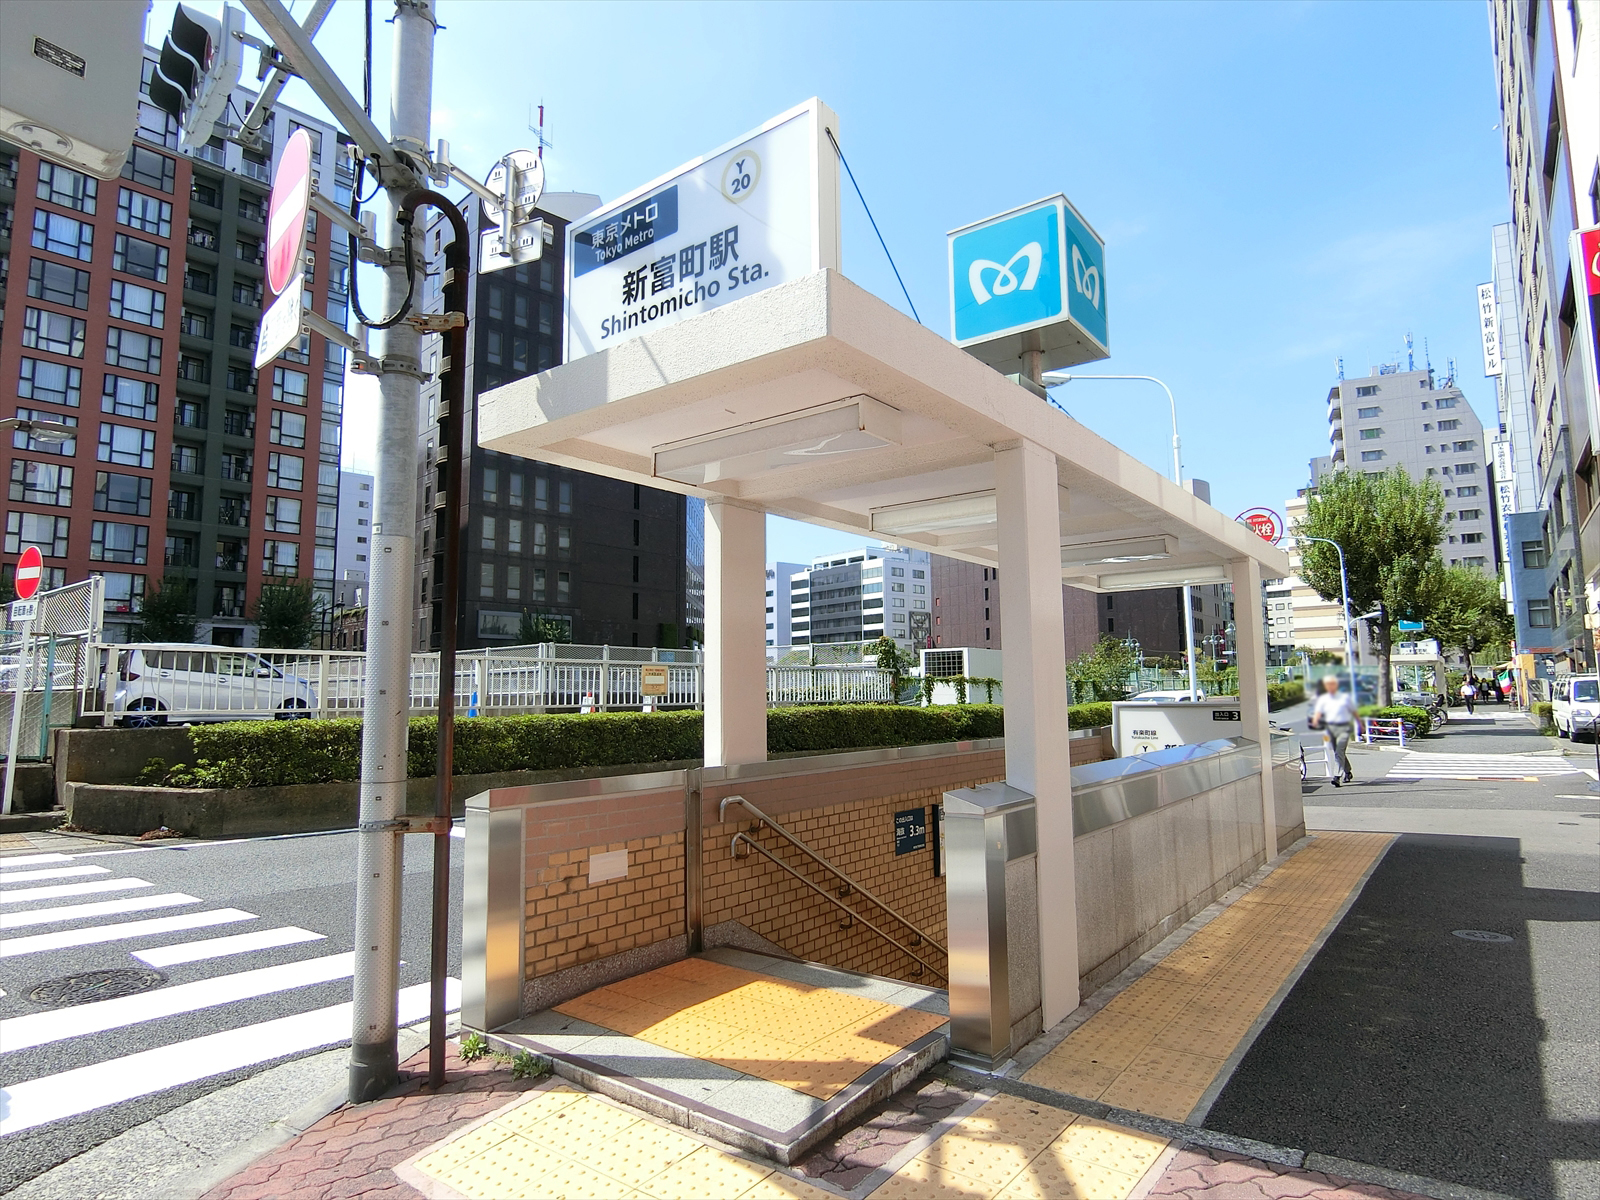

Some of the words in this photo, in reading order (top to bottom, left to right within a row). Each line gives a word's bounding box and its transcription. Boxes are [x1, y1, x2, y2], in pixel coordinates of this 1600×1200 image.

[731, 173, 751, 195] 20
[736, 159, 746, 175] Y
[591, 202, 659, 250] 東京メトロ
[595, 242, 623, 262] Tokyo
[624, 228, 654, 250] Metro
[622, 224, 739, 306] 新富町駅
[601, 280, 721, 340] Shintomicho
[728, 262, 770, 291] Sta.
[1481, 287, 1498, 370] 松竹新富ビル
[1232, 711, 1239, 720] 3
[909, 824, 925, 837] 3.3m
